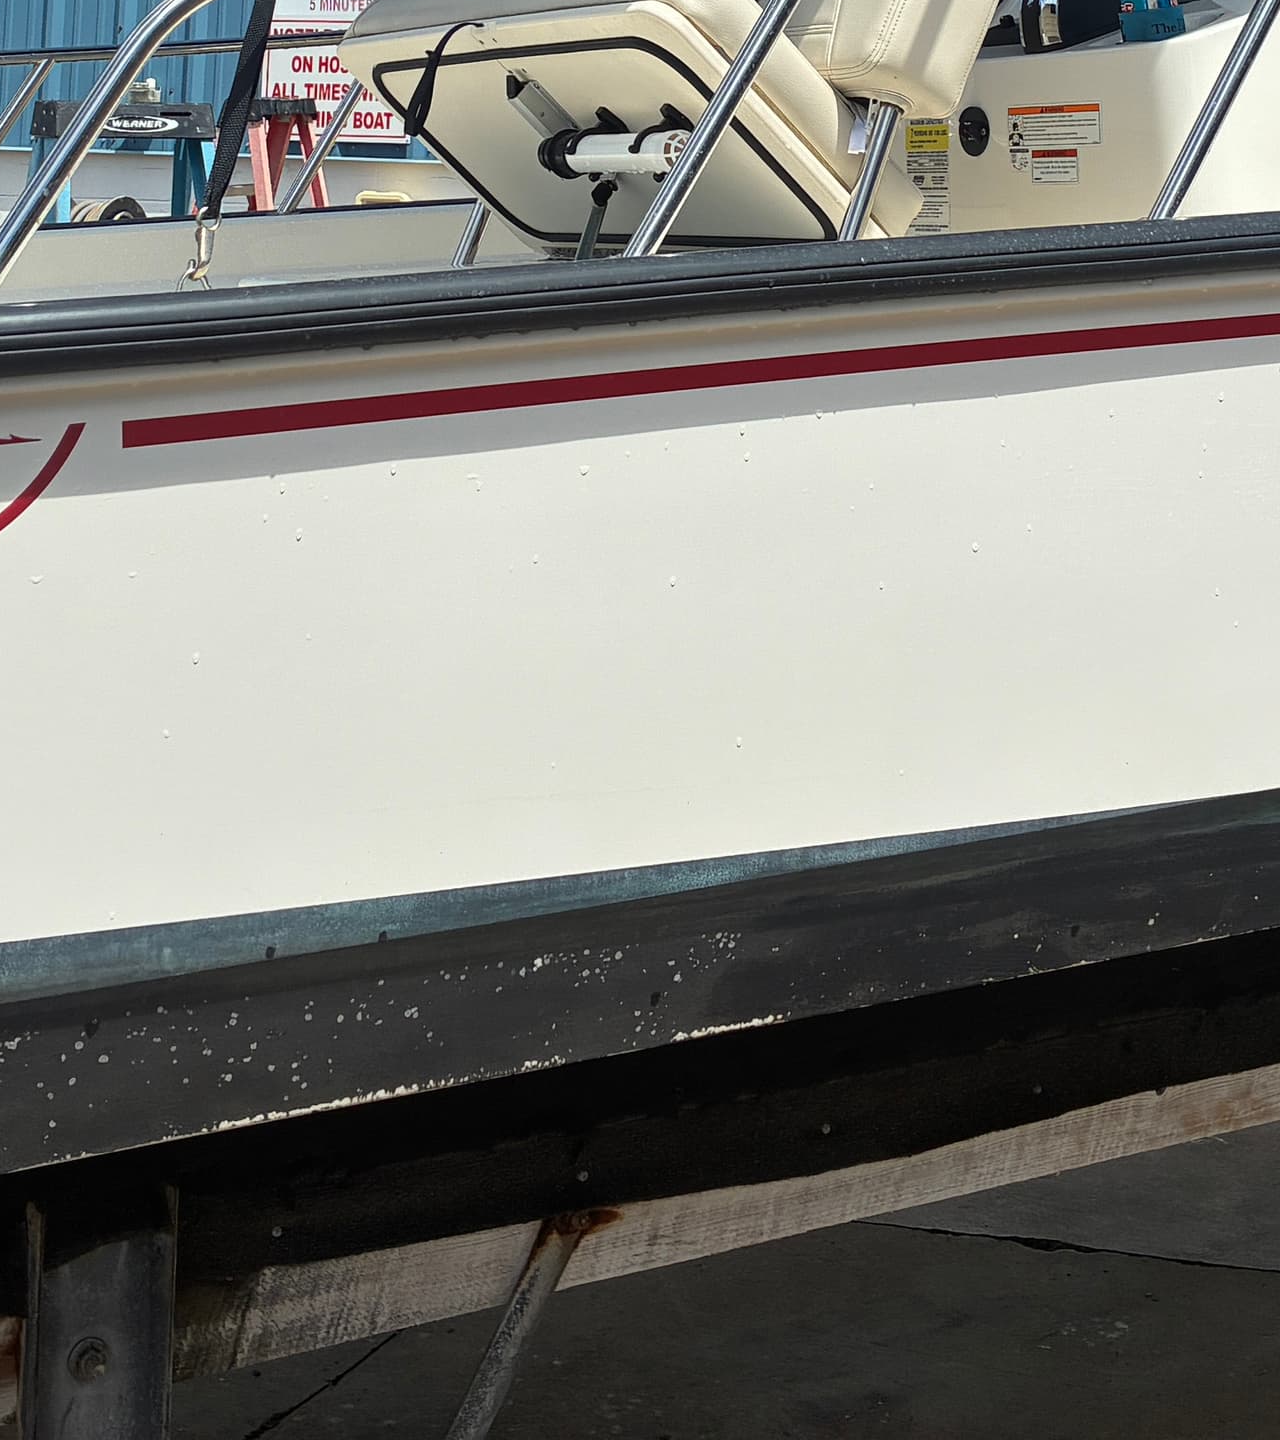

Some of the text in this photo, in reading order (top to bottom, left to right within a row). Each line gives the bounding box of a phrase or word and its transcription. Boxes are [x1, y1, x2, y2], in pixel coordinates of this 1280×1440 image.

[291, 55, 349, 74] ON HO
[272, 83, 299, 98] ALL
[305, 83, 350, 101] TIMES
[111, 119, 162, 128] WERNER
[353, 112, 393, 130] BOAT
